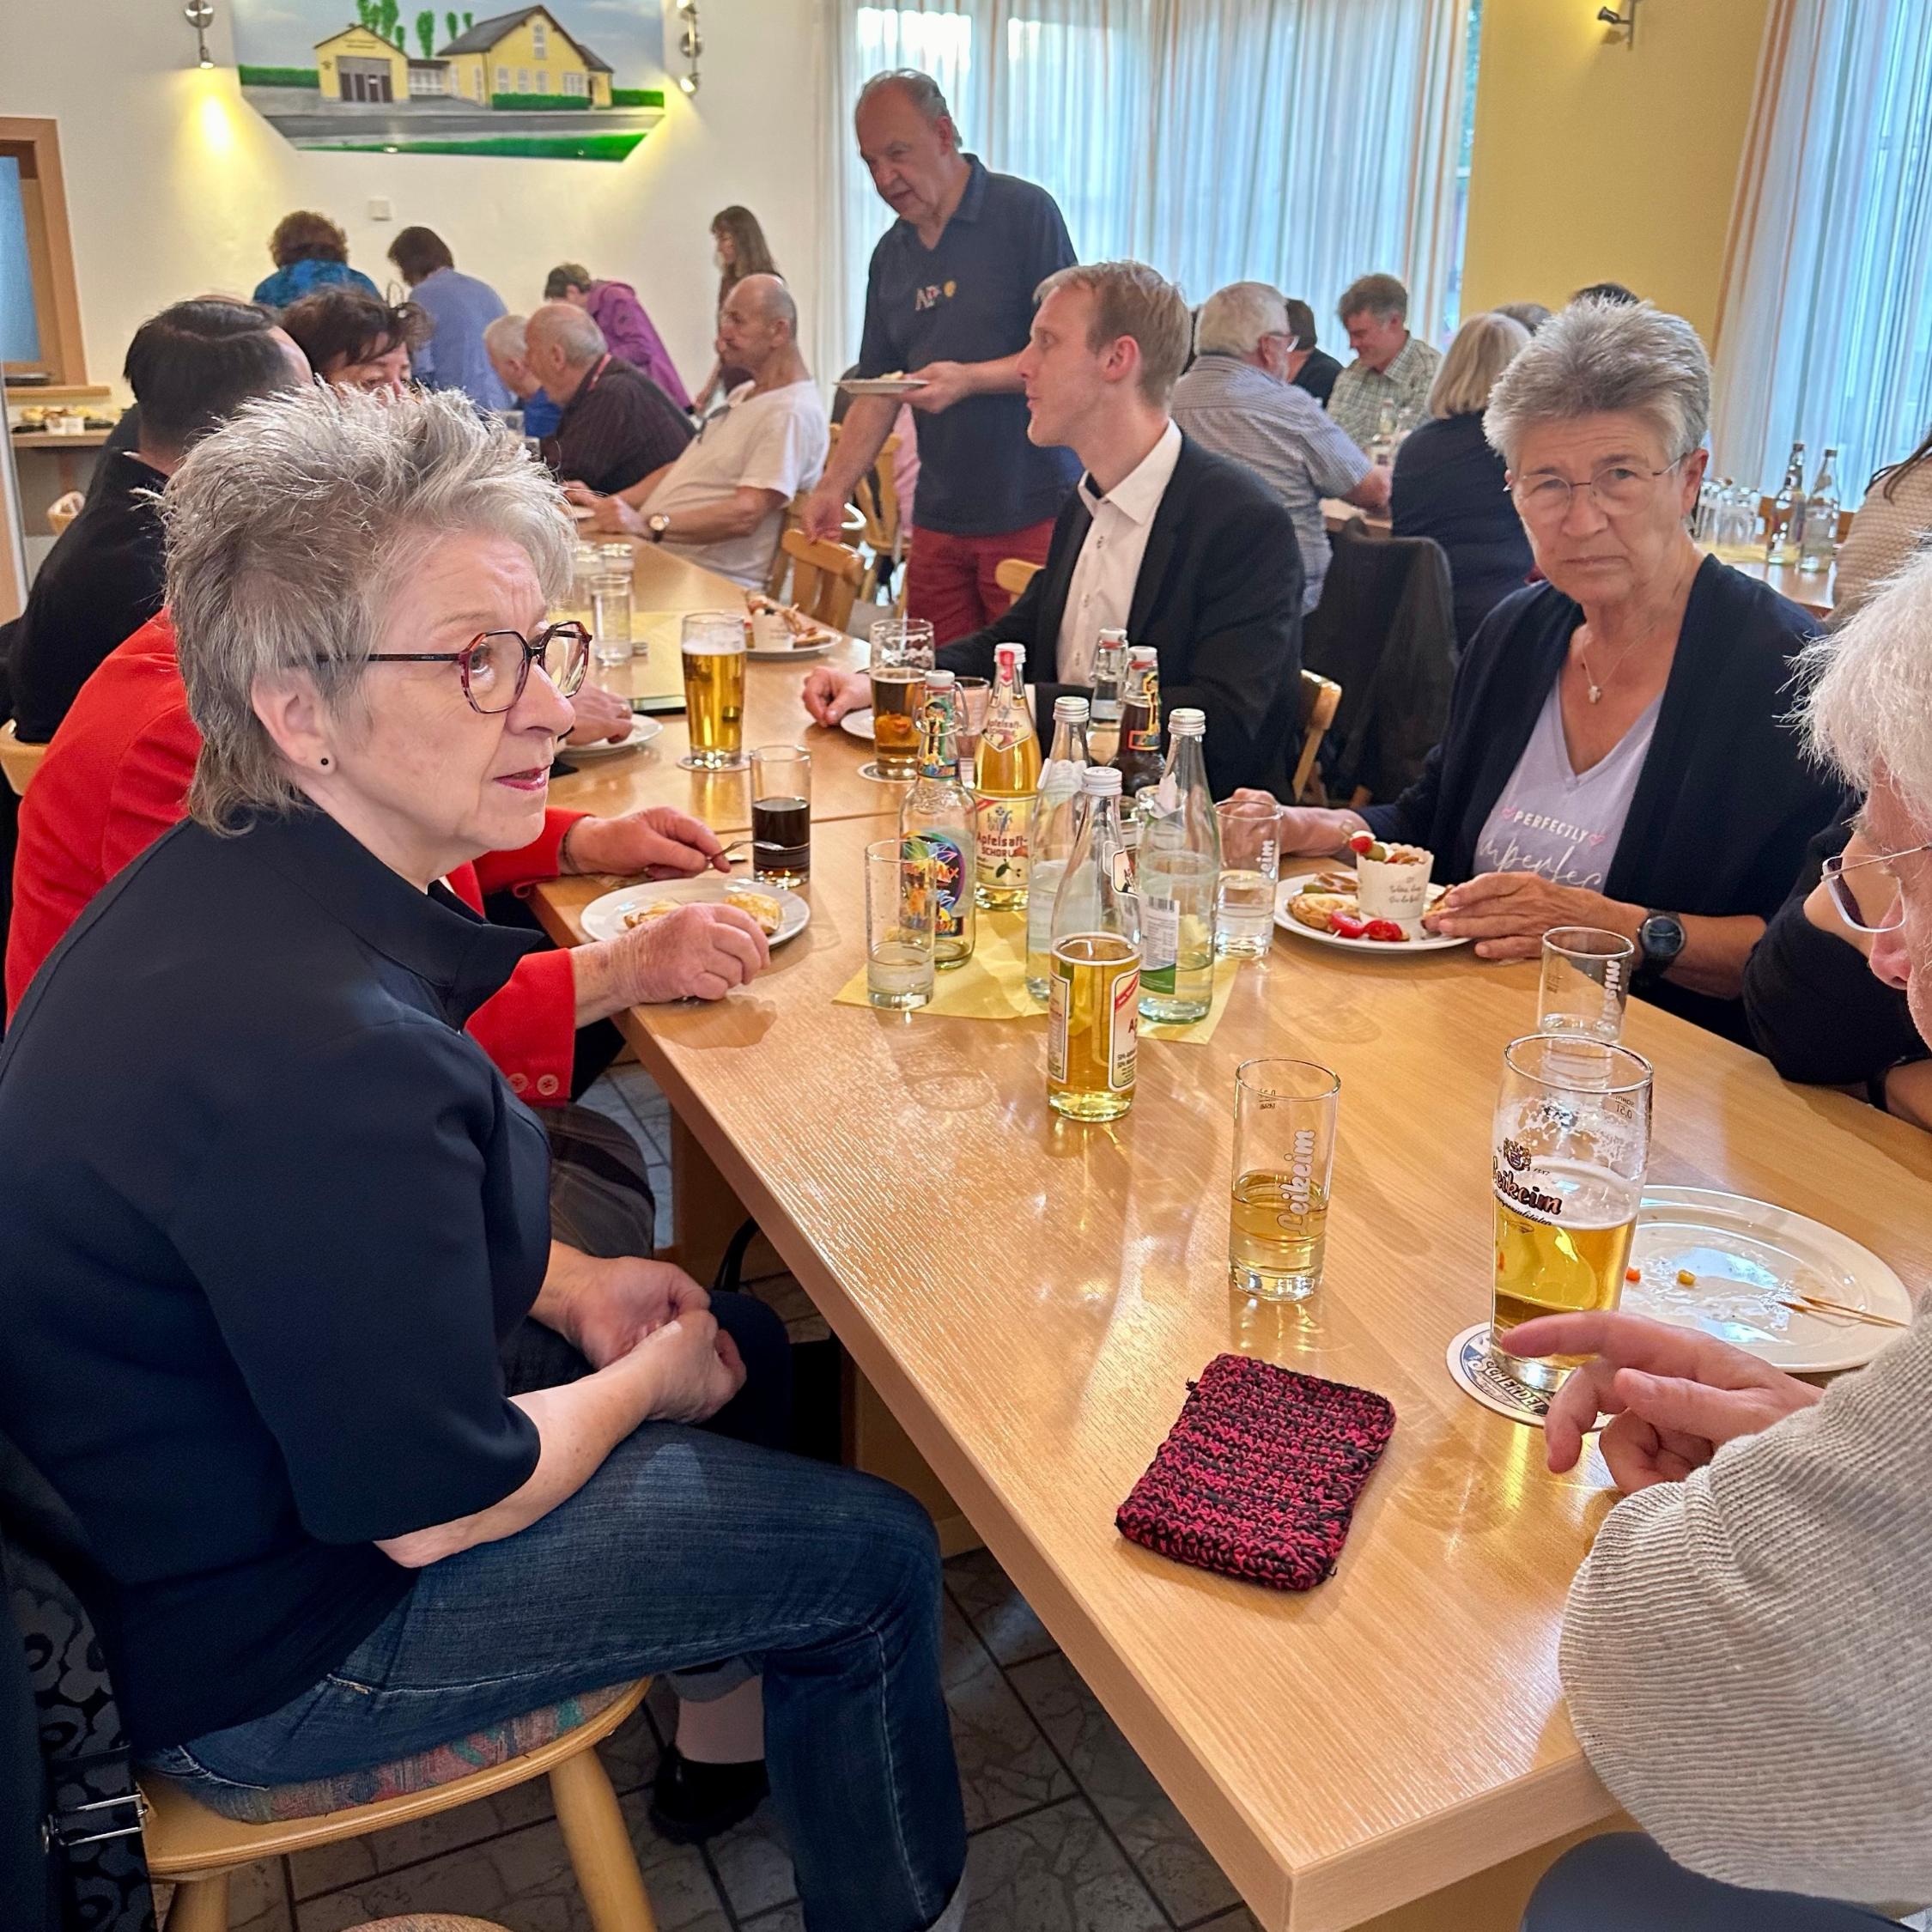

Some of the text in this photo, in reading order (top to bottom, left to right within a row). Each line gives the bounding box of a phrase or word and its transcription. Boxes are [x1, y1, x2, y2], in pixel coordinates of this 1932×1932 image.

[1513, 810, 1589, 844] PERFECTLY
[1277, 1129, 1315, 1236] Leikeim
[1467, 1357, 1546, 1412] SCHERDEL
